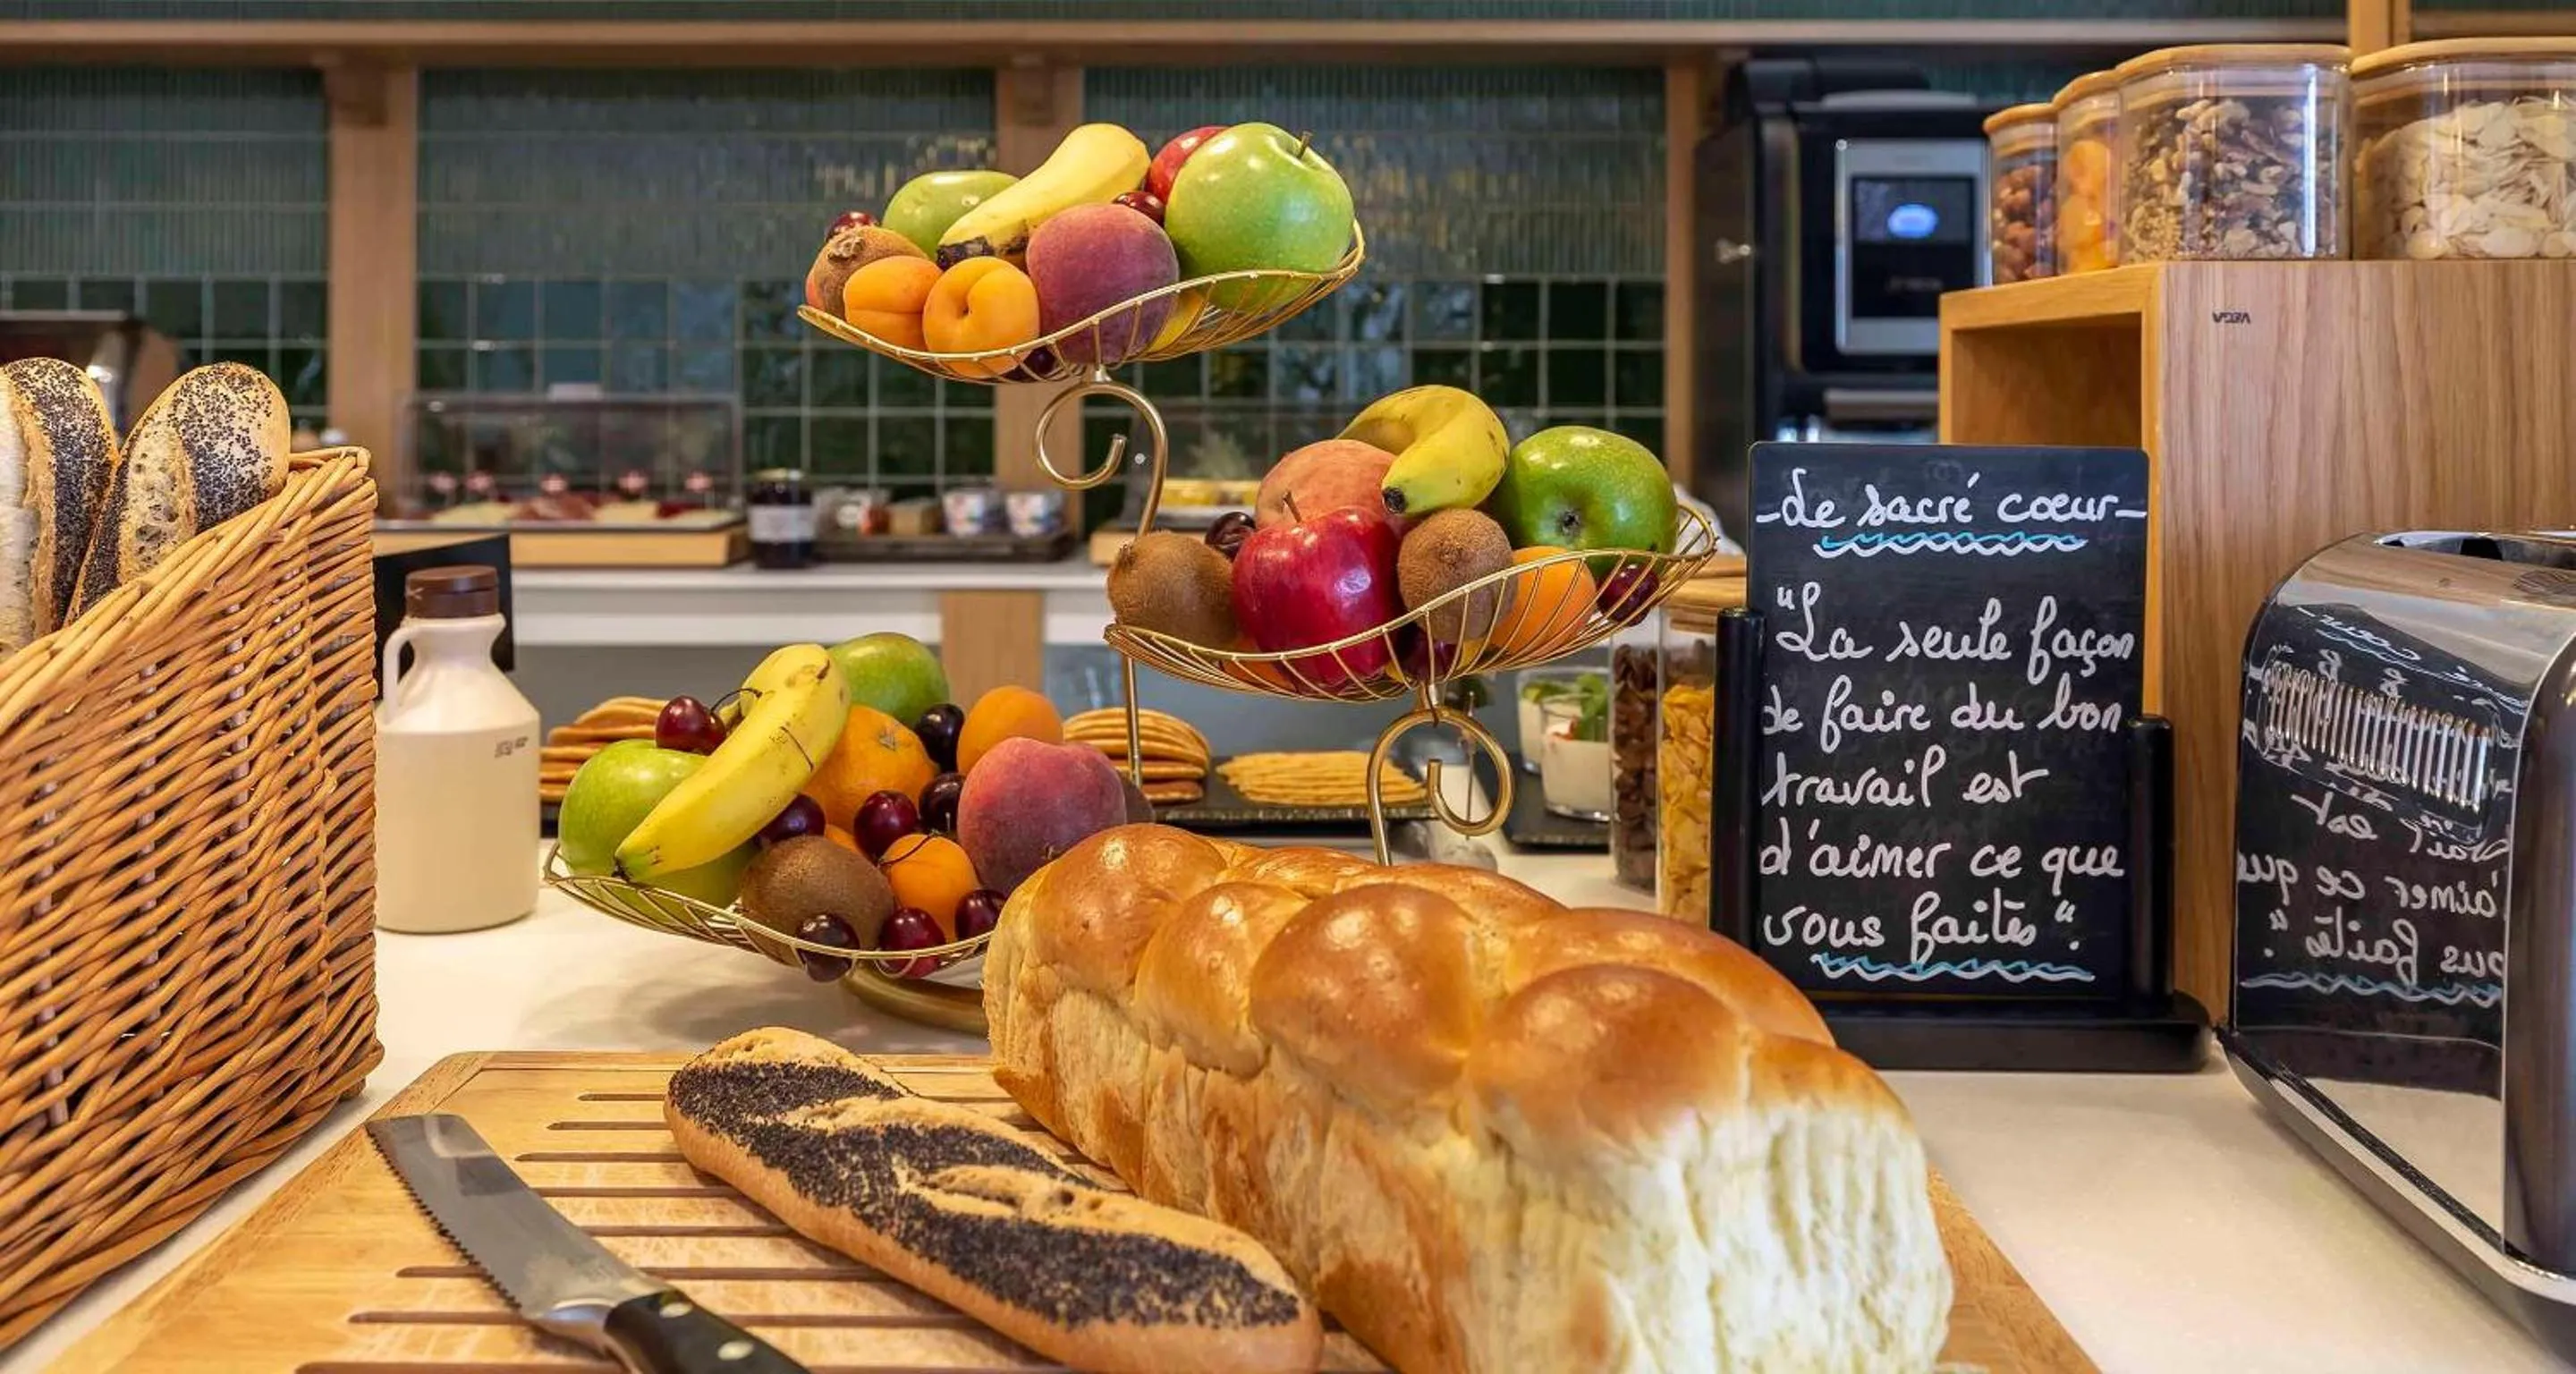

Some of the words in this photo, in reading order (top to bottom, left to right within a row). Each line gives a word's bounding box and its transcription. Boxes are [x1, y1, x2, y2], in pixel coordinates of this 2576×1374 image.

[1857, 472, 1979, 528] sacré
[1885, 597, 2012, 662] seule
[2027, 595, 2135, 685] façon
[1763, 684, 1804, 734] de
[1820, 674, 1931, 753] faire
[1950, 682, 2024, 732] du
[2038, 672, 2122, 733] bon
[1761, 744, 1946, 807] travail
[1962, 750, 2049, 803] est
[1759, 817, 1951, 878] d'aimer
[1970, 844, 2023, 878] ce
[2041, 844, 2125, 896] que
[1764, 905, 1885, 947] vous
